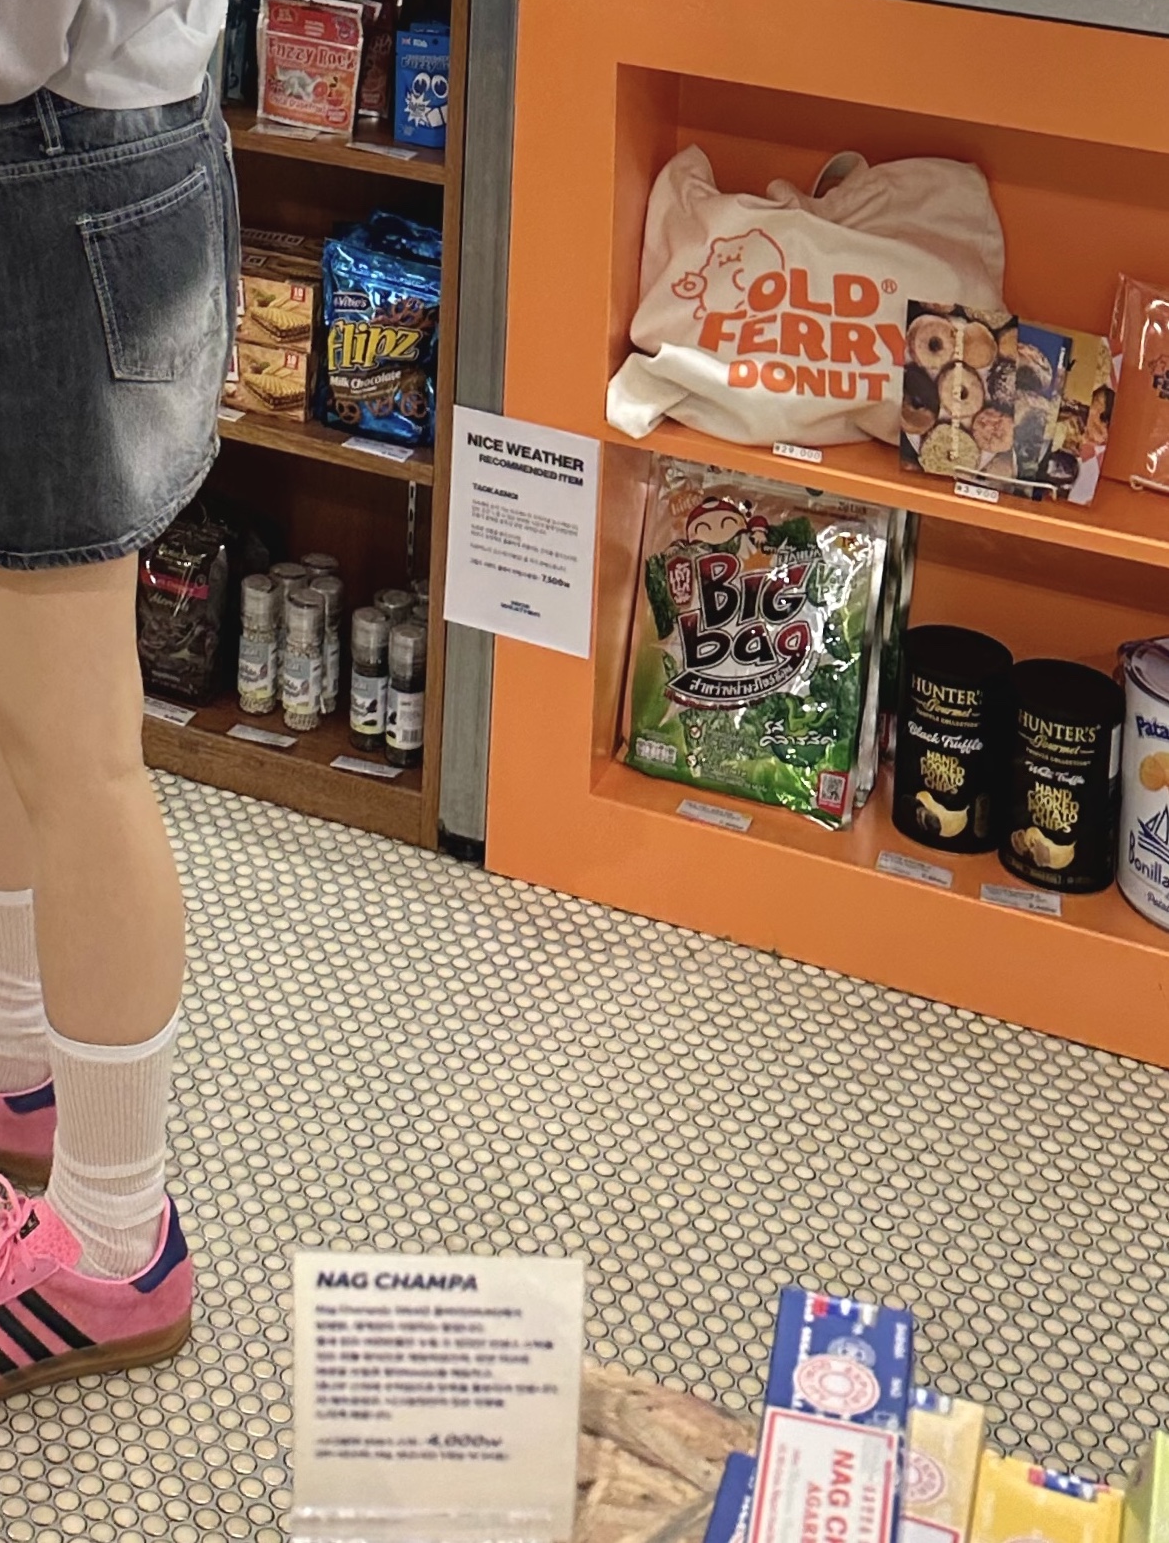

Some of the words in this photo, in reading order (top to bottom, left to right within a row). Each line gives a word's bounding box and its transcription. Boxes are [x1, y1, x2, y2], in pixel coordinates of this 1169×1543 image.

[268, 36, 315, 64] Fuzzy
[316, 45, 357, 71] Rock
[327, 319, 422, 373] flipz
[330, 375, 350, 389] Milk
[350, 369, 402, 389] Chocolate
[728, 359, 891, 402] DONUT
[467, 431, 504, 453] NICE
[506, 440, 585, 473] WEATHER
[478, 453, 558, 481] RECOMMENDED
[558, 473, 584, 487] ITEM
[677, 613, 812, 674] bag
[907, 720, 941, 745] Black
[941, 734, 984, 754] Truffle
[1017, 708, 1097, 744] HUNTER'S
[316, 1271, 369, 1290] NAG
[375, 1271, 478, 1291] CHAMPA
[828, 1449, 854, 1508] NAG
